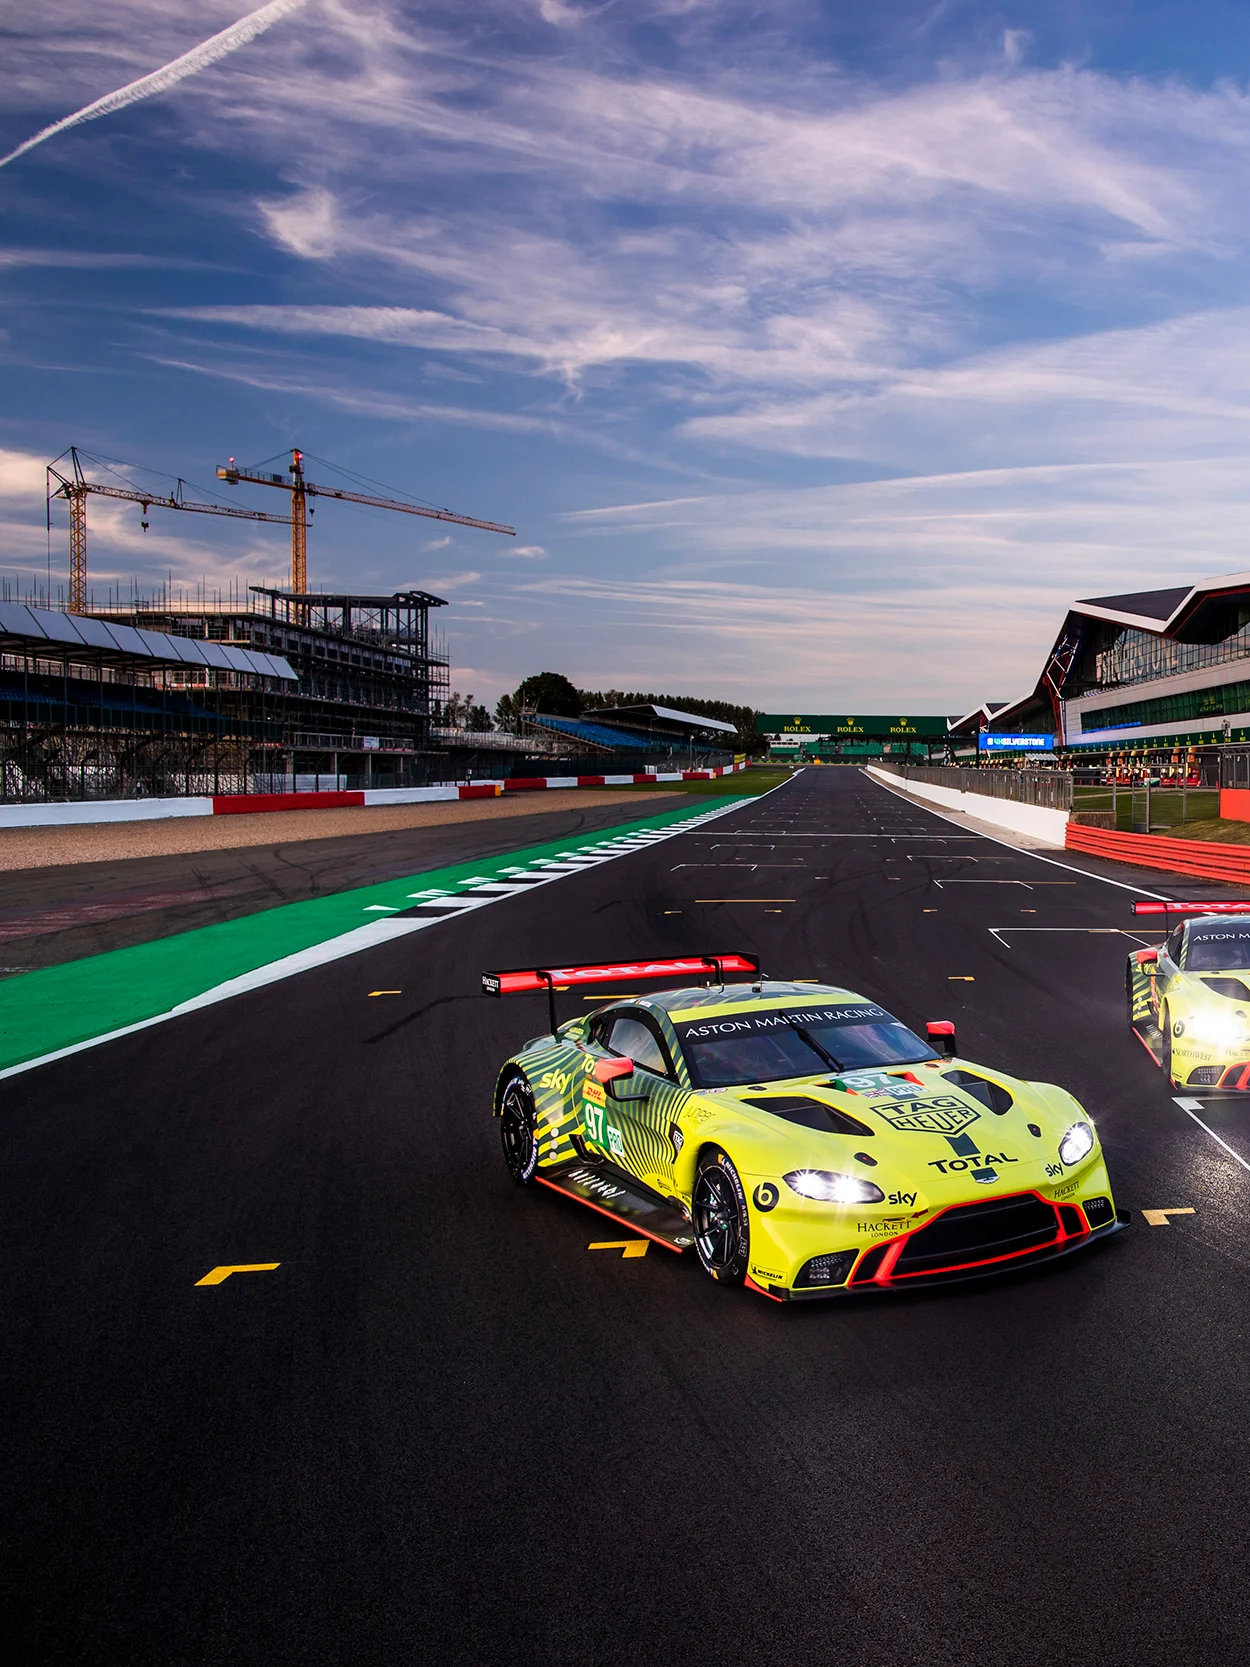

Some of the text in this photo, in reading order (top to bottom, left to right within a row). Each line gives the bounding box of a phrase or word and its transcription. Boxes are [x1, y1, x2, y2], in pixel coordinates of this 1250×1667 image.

[1193, 933, 1235, 942] ASTON
[549, 961, 704, 980] TOTAL
[685, 1008, 884, 1038] ASTON MARTIN RACING
[1175, 1047, 1213, 1061] NORTHWEST
[539, 1068, 571, 1094] sky
[842, 1074, 893, 1089] 97
[892, 1084, 925, 1094] PRO
[586, 1087, 602, 1100] DHL
[881, 1098, 958, 1116] TAG
[585, 1103, 604, 1143] 97
[896, 1109, 974, 1130] HEUER
[608, 1131, 623, 1153] PRO
[928, 1152, 1018, 1174] TOTAL
[1045, 1162, 1064, 1177] sky
[725, 1161, 743, 1200] MICHELIN
[888, 1191, 917, 1207] sky
[1054, 1181, 1080, 1199] HACKETT
[857, 1220, 912, 1233] HACKETT
[757, 1269, 783, 1280] MICHELIN
